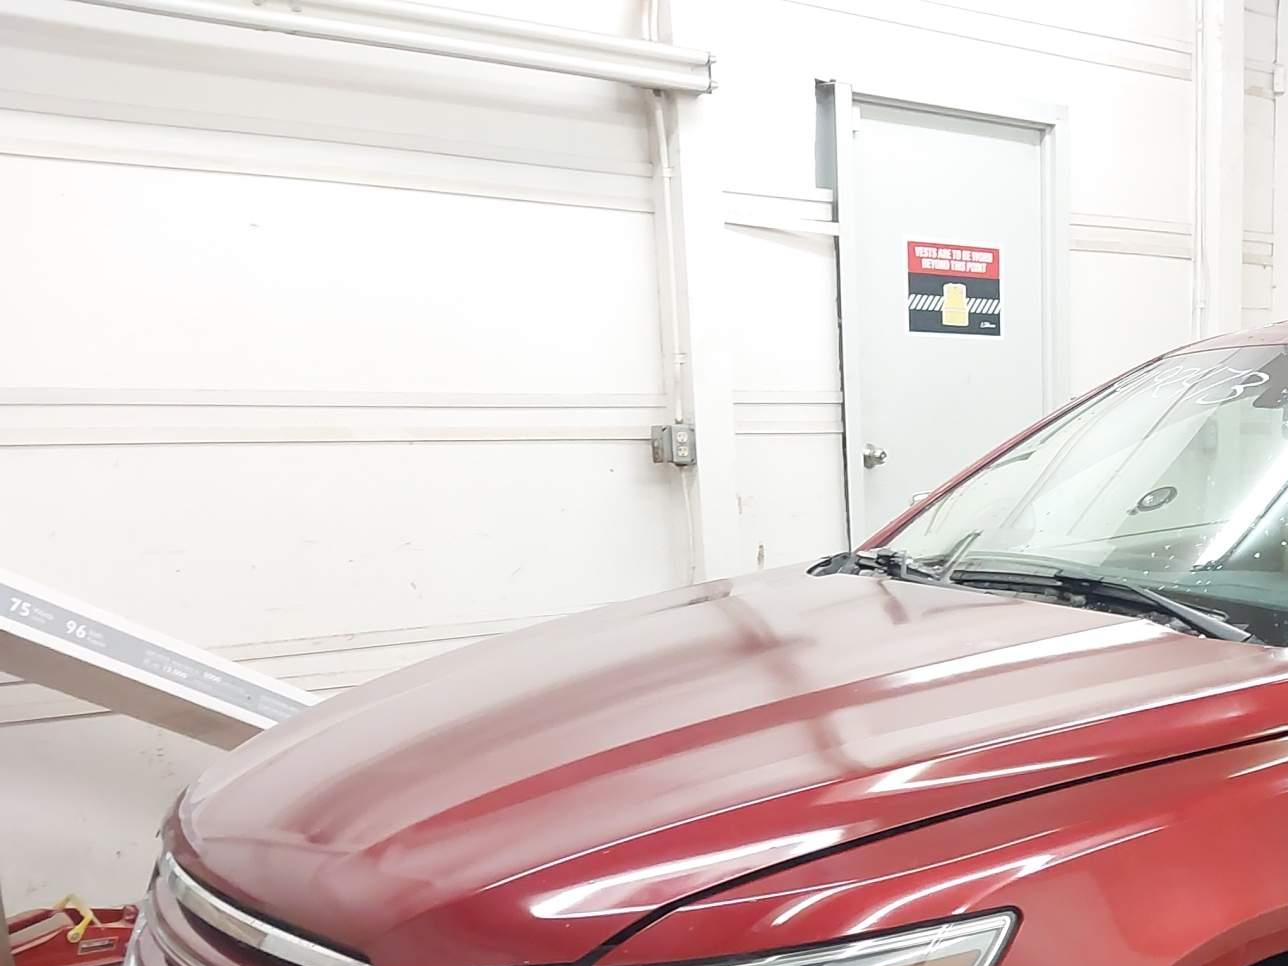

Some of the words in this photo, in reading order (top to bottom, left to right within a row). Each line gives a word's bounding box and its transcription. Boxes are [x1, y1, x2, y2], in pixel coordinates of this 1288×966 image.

[914, 246, 938, 258] VESTS
[938, 248, 952, 259] ARE
[952, 250, 962, 260] TO
[962, 250, 972, 261] BE
[951, 260, 966, 271] THIS
[966, 262, 986, 273] POINT
[9, 597, 32, 616] 75
[66, 620, 87, 638] 96
